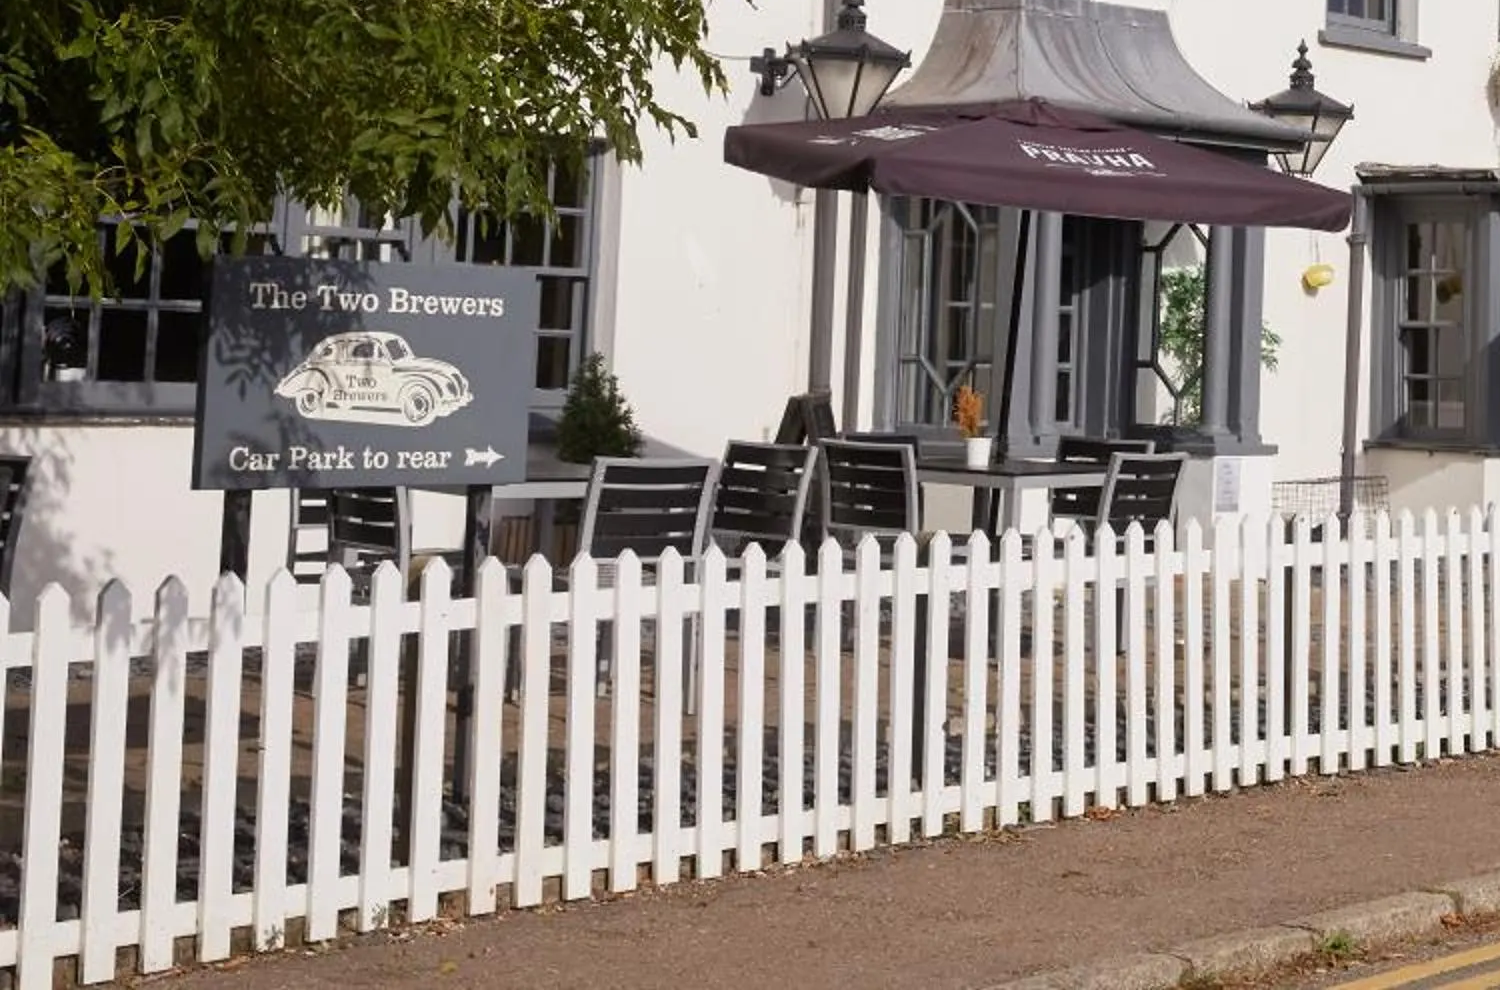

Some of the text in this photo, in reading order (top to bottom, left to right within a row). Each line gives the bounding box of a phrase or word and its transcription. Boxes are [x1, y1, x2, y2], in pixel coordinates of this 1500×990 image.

[249, 282, 505, 317] The Two Brewers
[345, 374, 377, 389] Two
[229, 445, 452, 471] Car Park to rear
